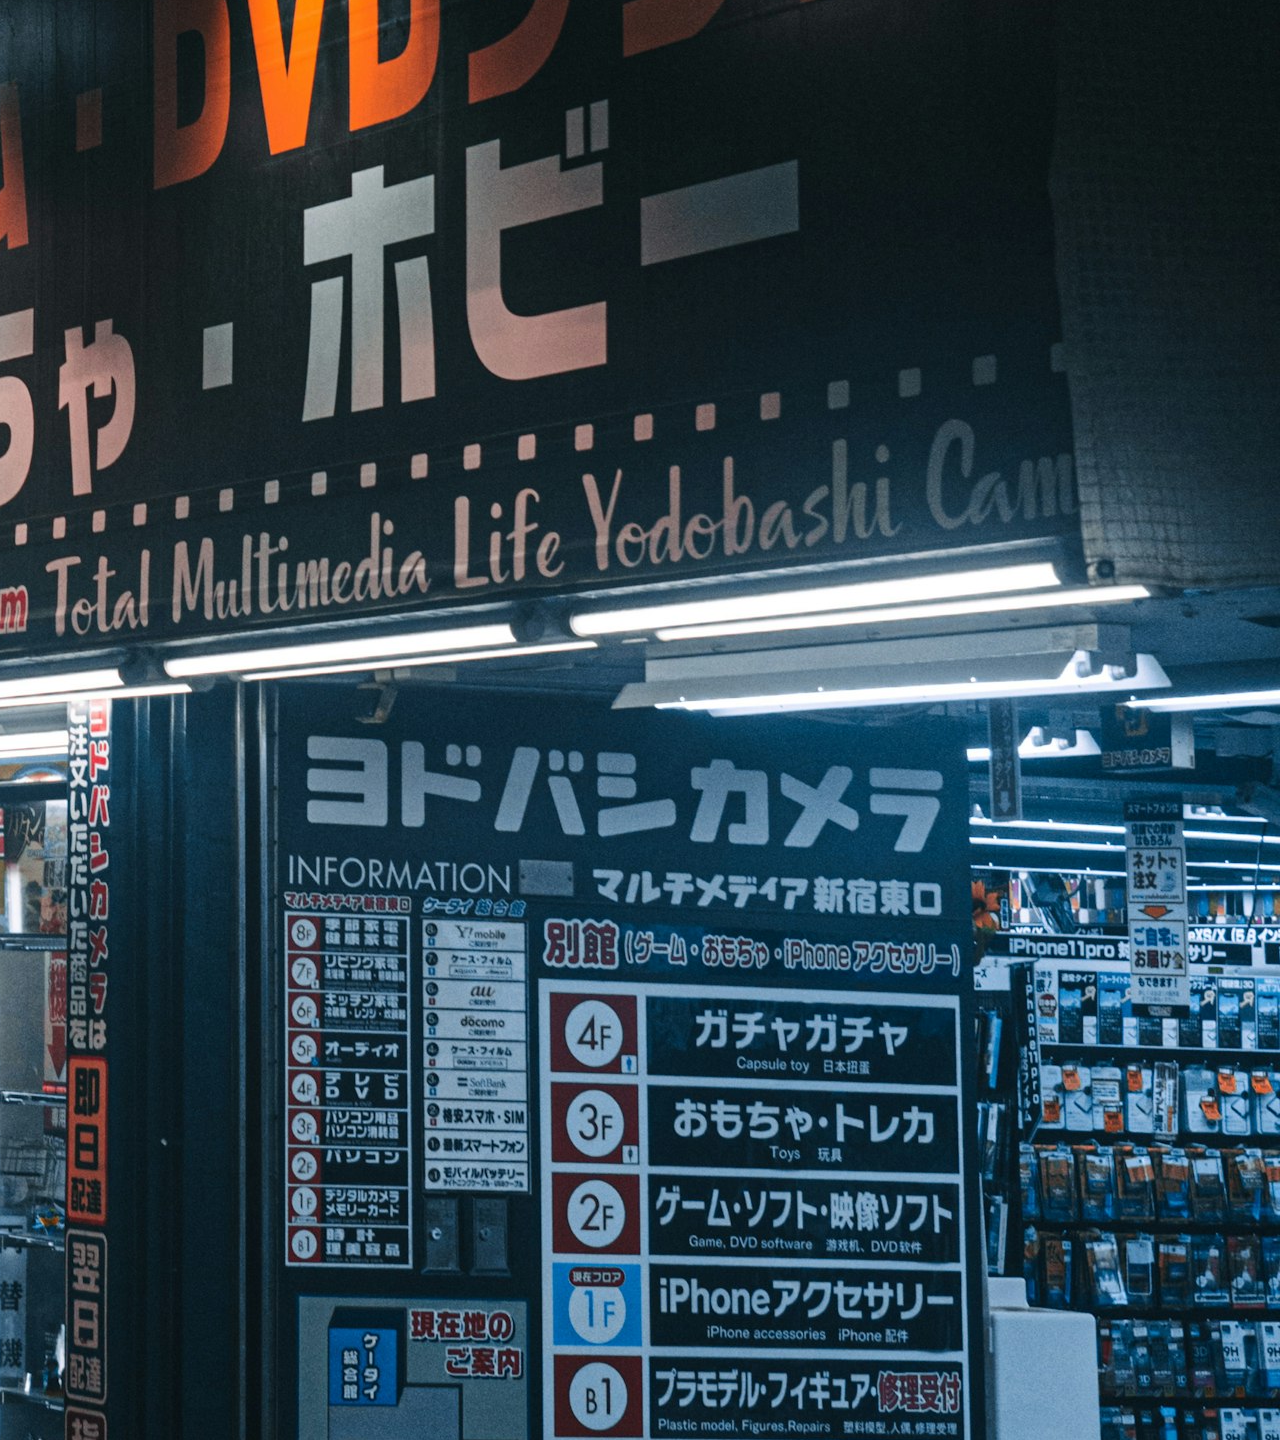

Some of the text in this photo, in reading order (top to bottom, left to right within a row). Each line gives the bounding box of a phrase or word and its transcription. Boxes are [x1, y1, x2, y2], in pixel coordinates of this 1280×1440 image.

[44, 549, 151, 638] Total
[173, 512, 430, 624] Multimedia
[452, 486, 566, 592] Life
[583, 440, 904, 575] Yodobashi
[1101, 747, 1171, 769] ヨドバシカメラ
[306, 734, 943, 853] ヨドバシカメラ
[1133, 851, 1177, 869] ネットで
[288, 855, 511, 894] INFORMATION
[593, 868, 942, 917] マルチメディア新宿東口
[296, 924, 313, 941] 8F
[1134, 927, 1180, 946] ご自宅に
[543, 919, 619, 970] 別館
[1009, 937, 1115, 960] iPhone11pro
[451, 954, 513, 966] ケース・フィルム
[1134, 949, 1172, 970] お届け
[296, 963, 313, 980] 7F
[470, 986, 496, 998] au
[296, 1002, 313, 1018] 6F
[577, 1015, 612, 1052] 4F
[695, 1008, 908, 1057] ガチャガチャ
[296, 1040, 313, 1057] 5F
[325, 1041, 400, 1058] オーディオ
[451, 1045, 513, 1057] ケース・フィルム
[737, 1056, 810, 1074] Capsule toy
[822, 1059, 871, 1076] 日本扭蛋
[297, 1080, 313, 1096] 4F
[470, 1078, 507, 1089] SoftBank
[325, 1110, 400, 1126] パソコン用品
[443, 1107, 525, 1125] 格安スマホ・SIM
[578, 1102, 613, 1141] 3F
[673, 1097, 935, 1143] おもちゃ・トレカ
[297, 1118, 313, 1135] 3F
[443, 1138, 525, 1153] 最新スマートフォン
[769, 1145, 801, 1161] Toys
[326, 1149, 400, 1164] パソコン
[817, 1147, 843, 1163] 玩具
[297, 1156, 313, 1174] 2F
[443, 1166, 525, 1179] モバイルバッテリー
[298, 1192, 313, 1210] 1F
[325, 1188, 400, 1204] デジタルカメラ
[325, 1202, 400, 1218] メモリーカード
[580, 1193, 614, 1231] 2F
[655, 1186, 954, 1234] ゲーム・ソフト・映像ソフト
[297, 1235, 311, 1253] B1
[689, 1235, 813, 1252] Game, DVD software
[572, 1270, 622, 1284] 現在フロア
[659, 1276, 955, 1321] iPhoneアクセサリー
[584, 1290, 616, 1329] 1F
[410, 1308, 514, 1341] 現在地の
[706, 1325, 827, 1341] iPhone accessories
[838, 1328, 909, 1344] iPhone 配件
[1223, 1345, 1240, 1357] 9H
[362, 1332, 379, 1401] ケータイ
[445, 1346, 523, 1378] ご案内
[342, 1348, 360, 1400] 総合館
[586, 1378, 612, 1415] B1
[658, 1417, 698, 1431] Plastic
[700, 1418, 739, 1433] model,
